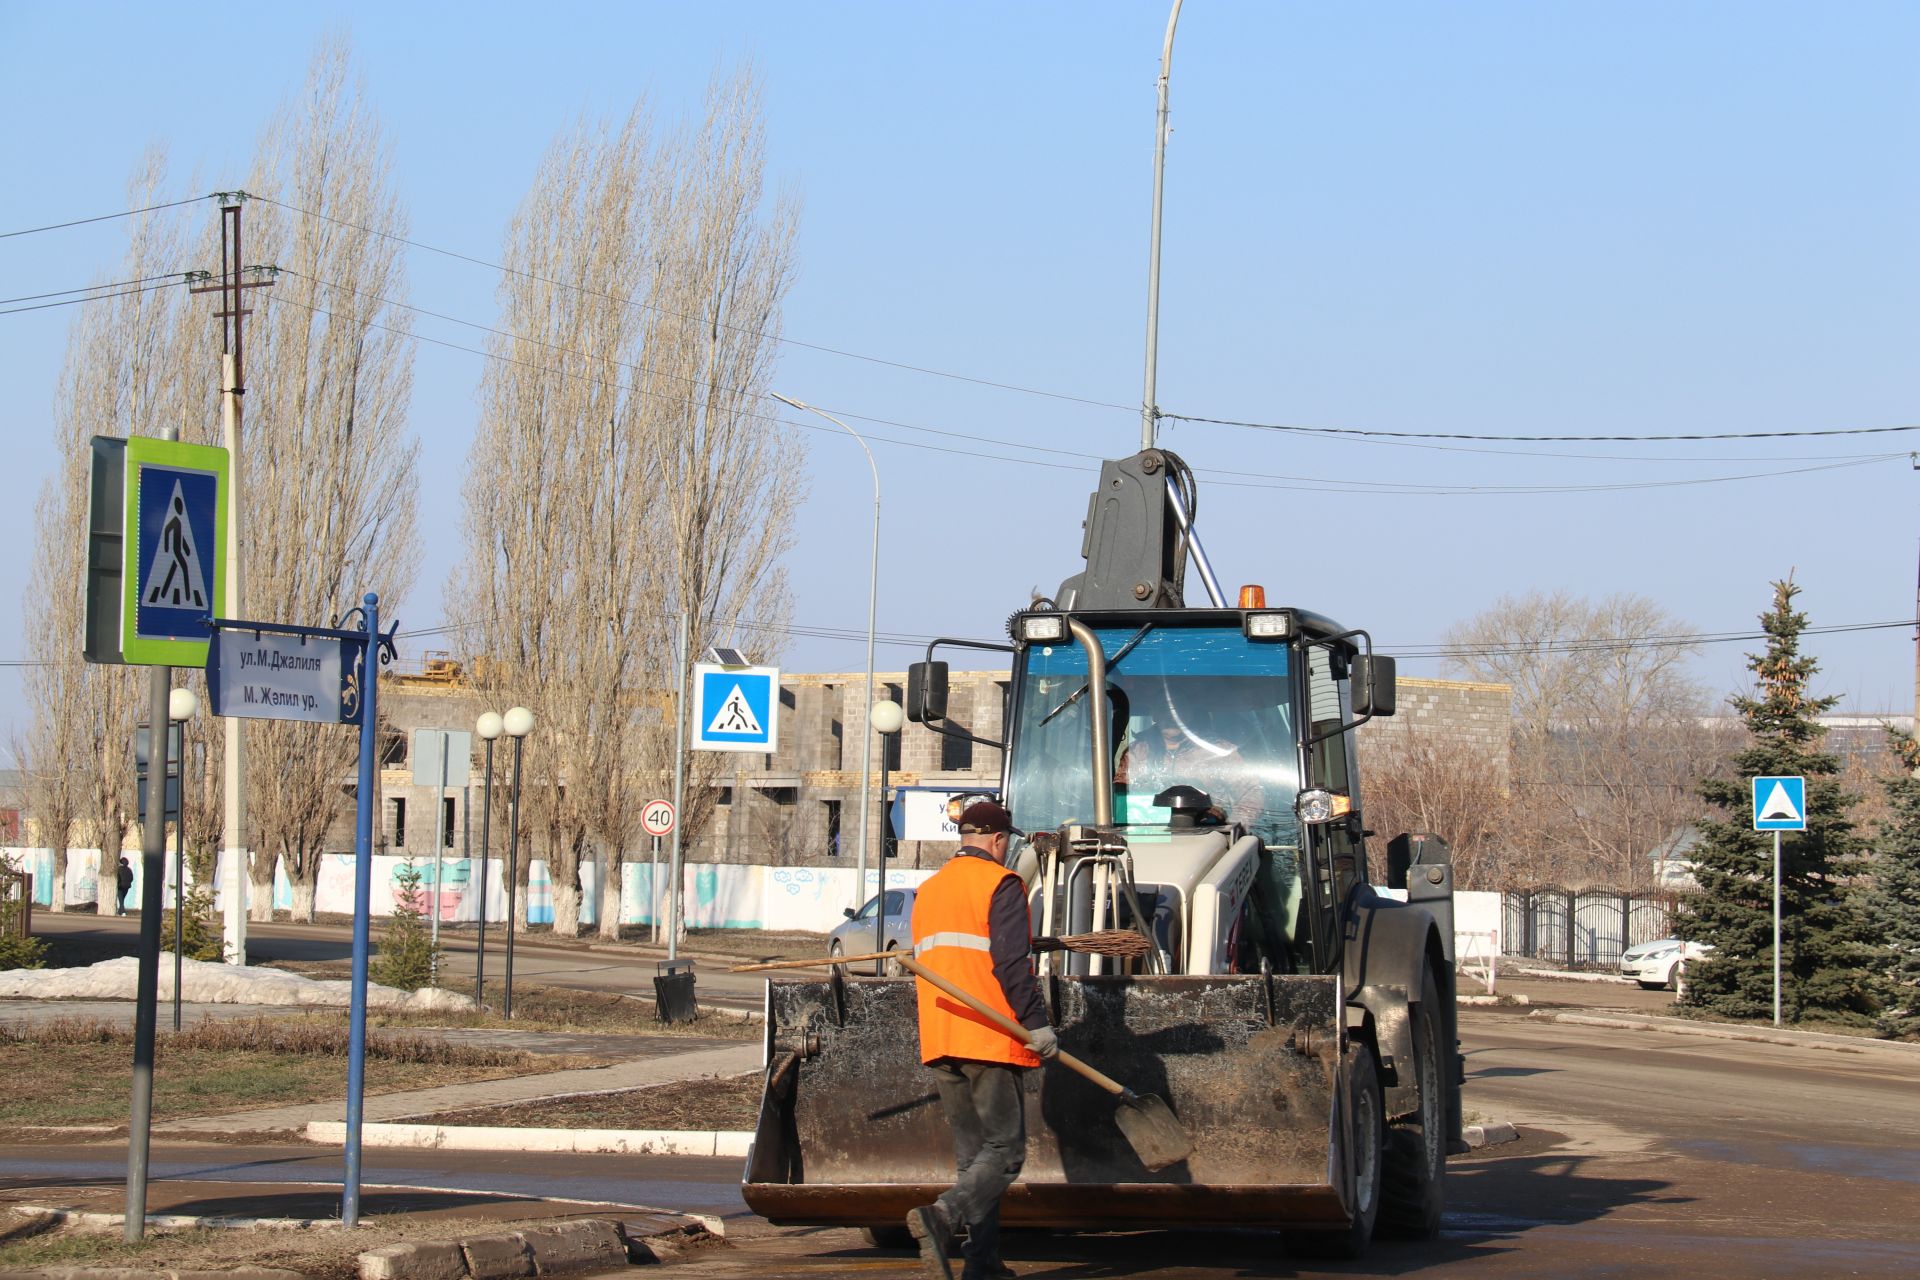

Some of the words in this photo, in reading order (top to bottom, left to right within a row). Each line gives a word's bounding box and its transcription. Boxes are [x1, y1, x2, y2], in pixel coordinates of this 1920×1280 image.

[243, 685, 258, 703] М.
[301, 693, 318, 711] ур.
[648, 809, 670, 826] 40
